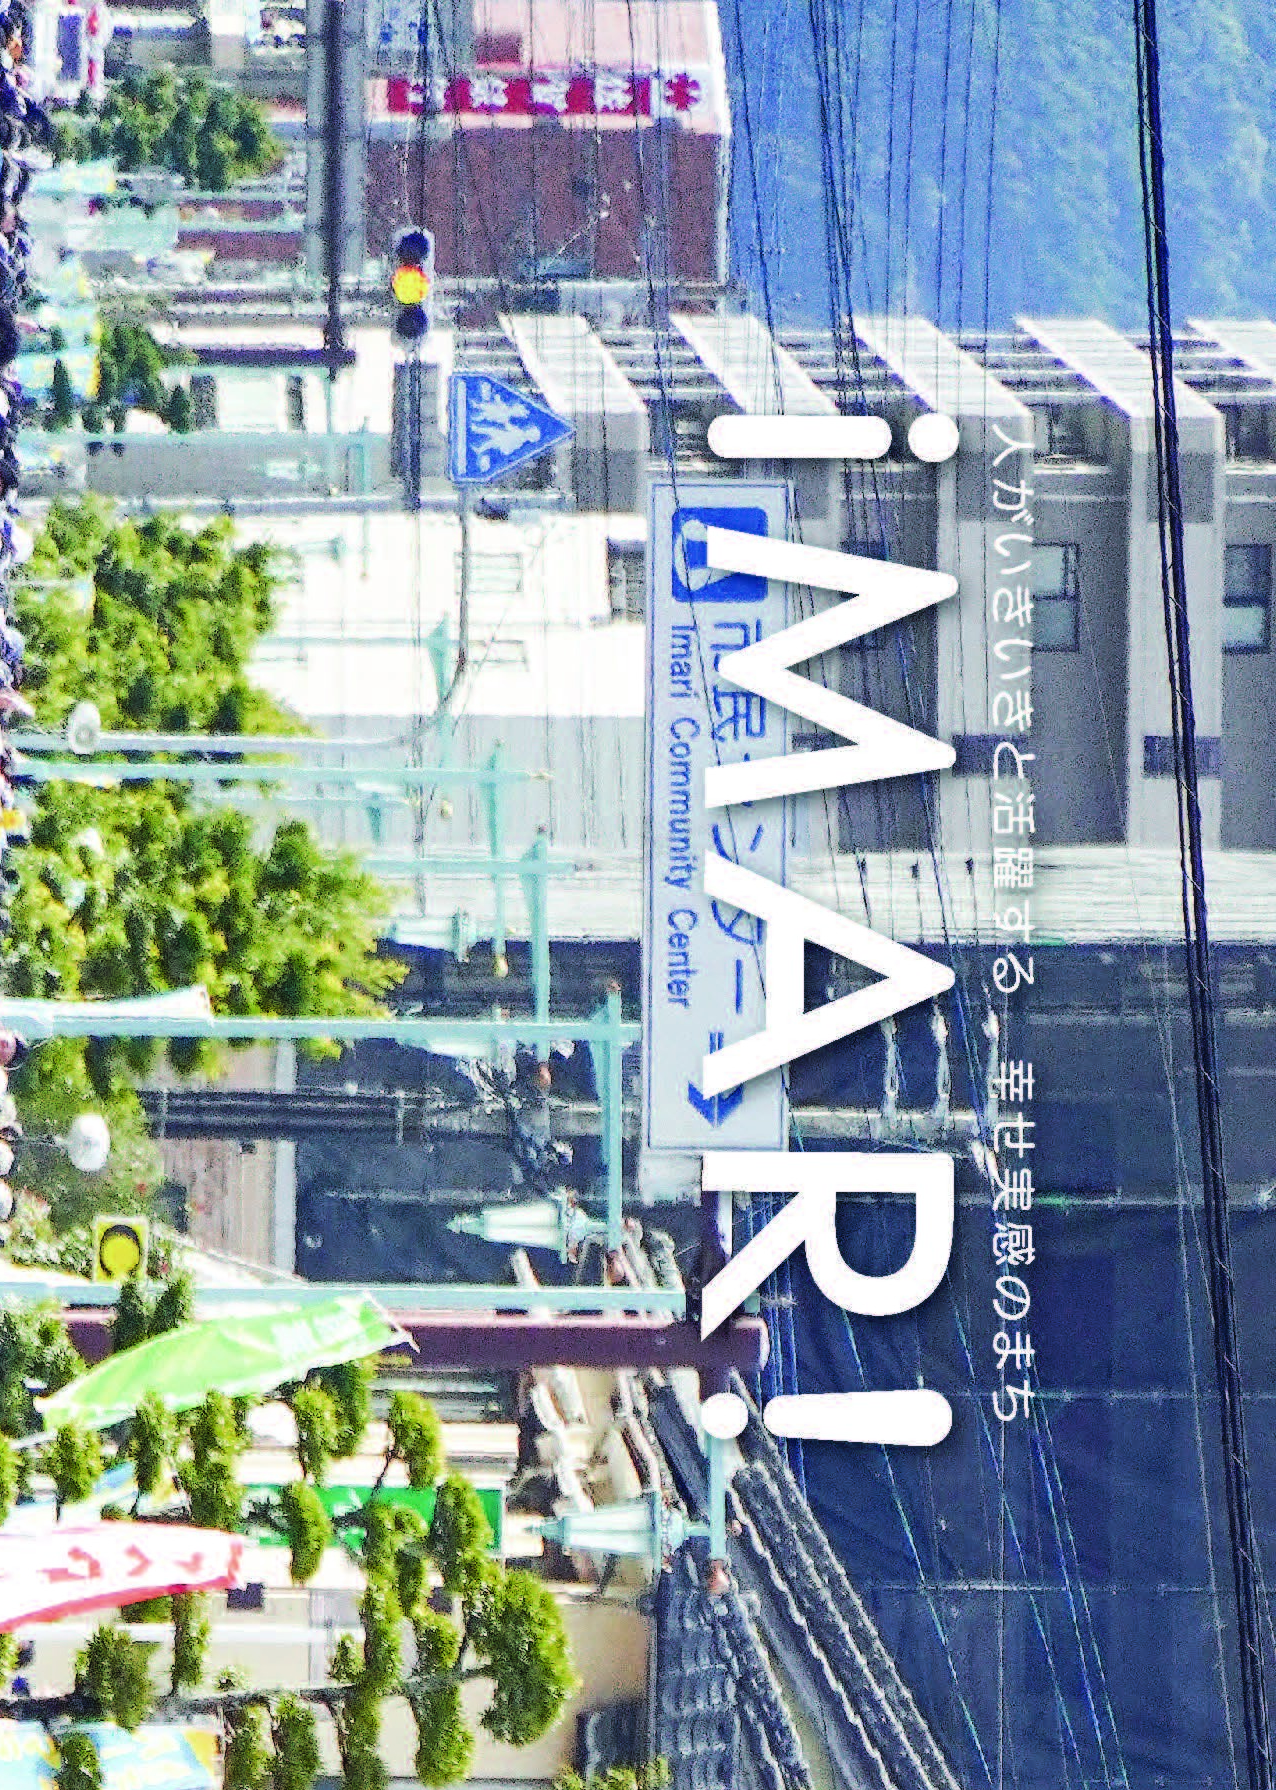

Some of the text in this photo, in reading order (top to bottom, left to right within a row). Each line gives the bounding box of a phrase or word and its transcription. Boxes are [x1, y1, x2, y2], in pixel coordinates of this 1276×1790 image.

[662, 624, 701, 1009] Imari Community Center
